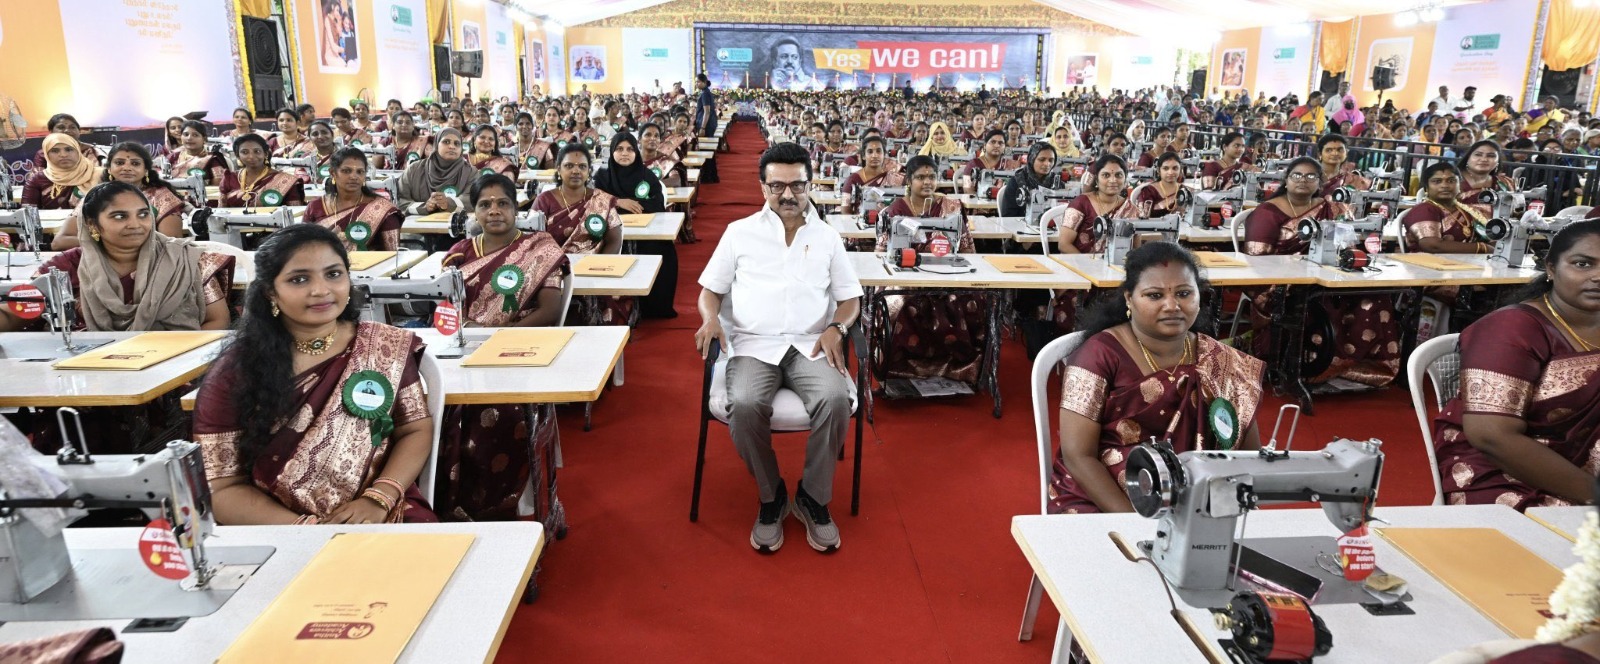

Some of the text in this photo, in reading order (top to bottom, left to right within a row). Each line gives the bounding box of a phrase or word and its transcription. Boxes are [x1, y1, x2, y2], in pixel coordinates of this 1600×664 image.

[823, 44, 1000, 68] Yes we can!
